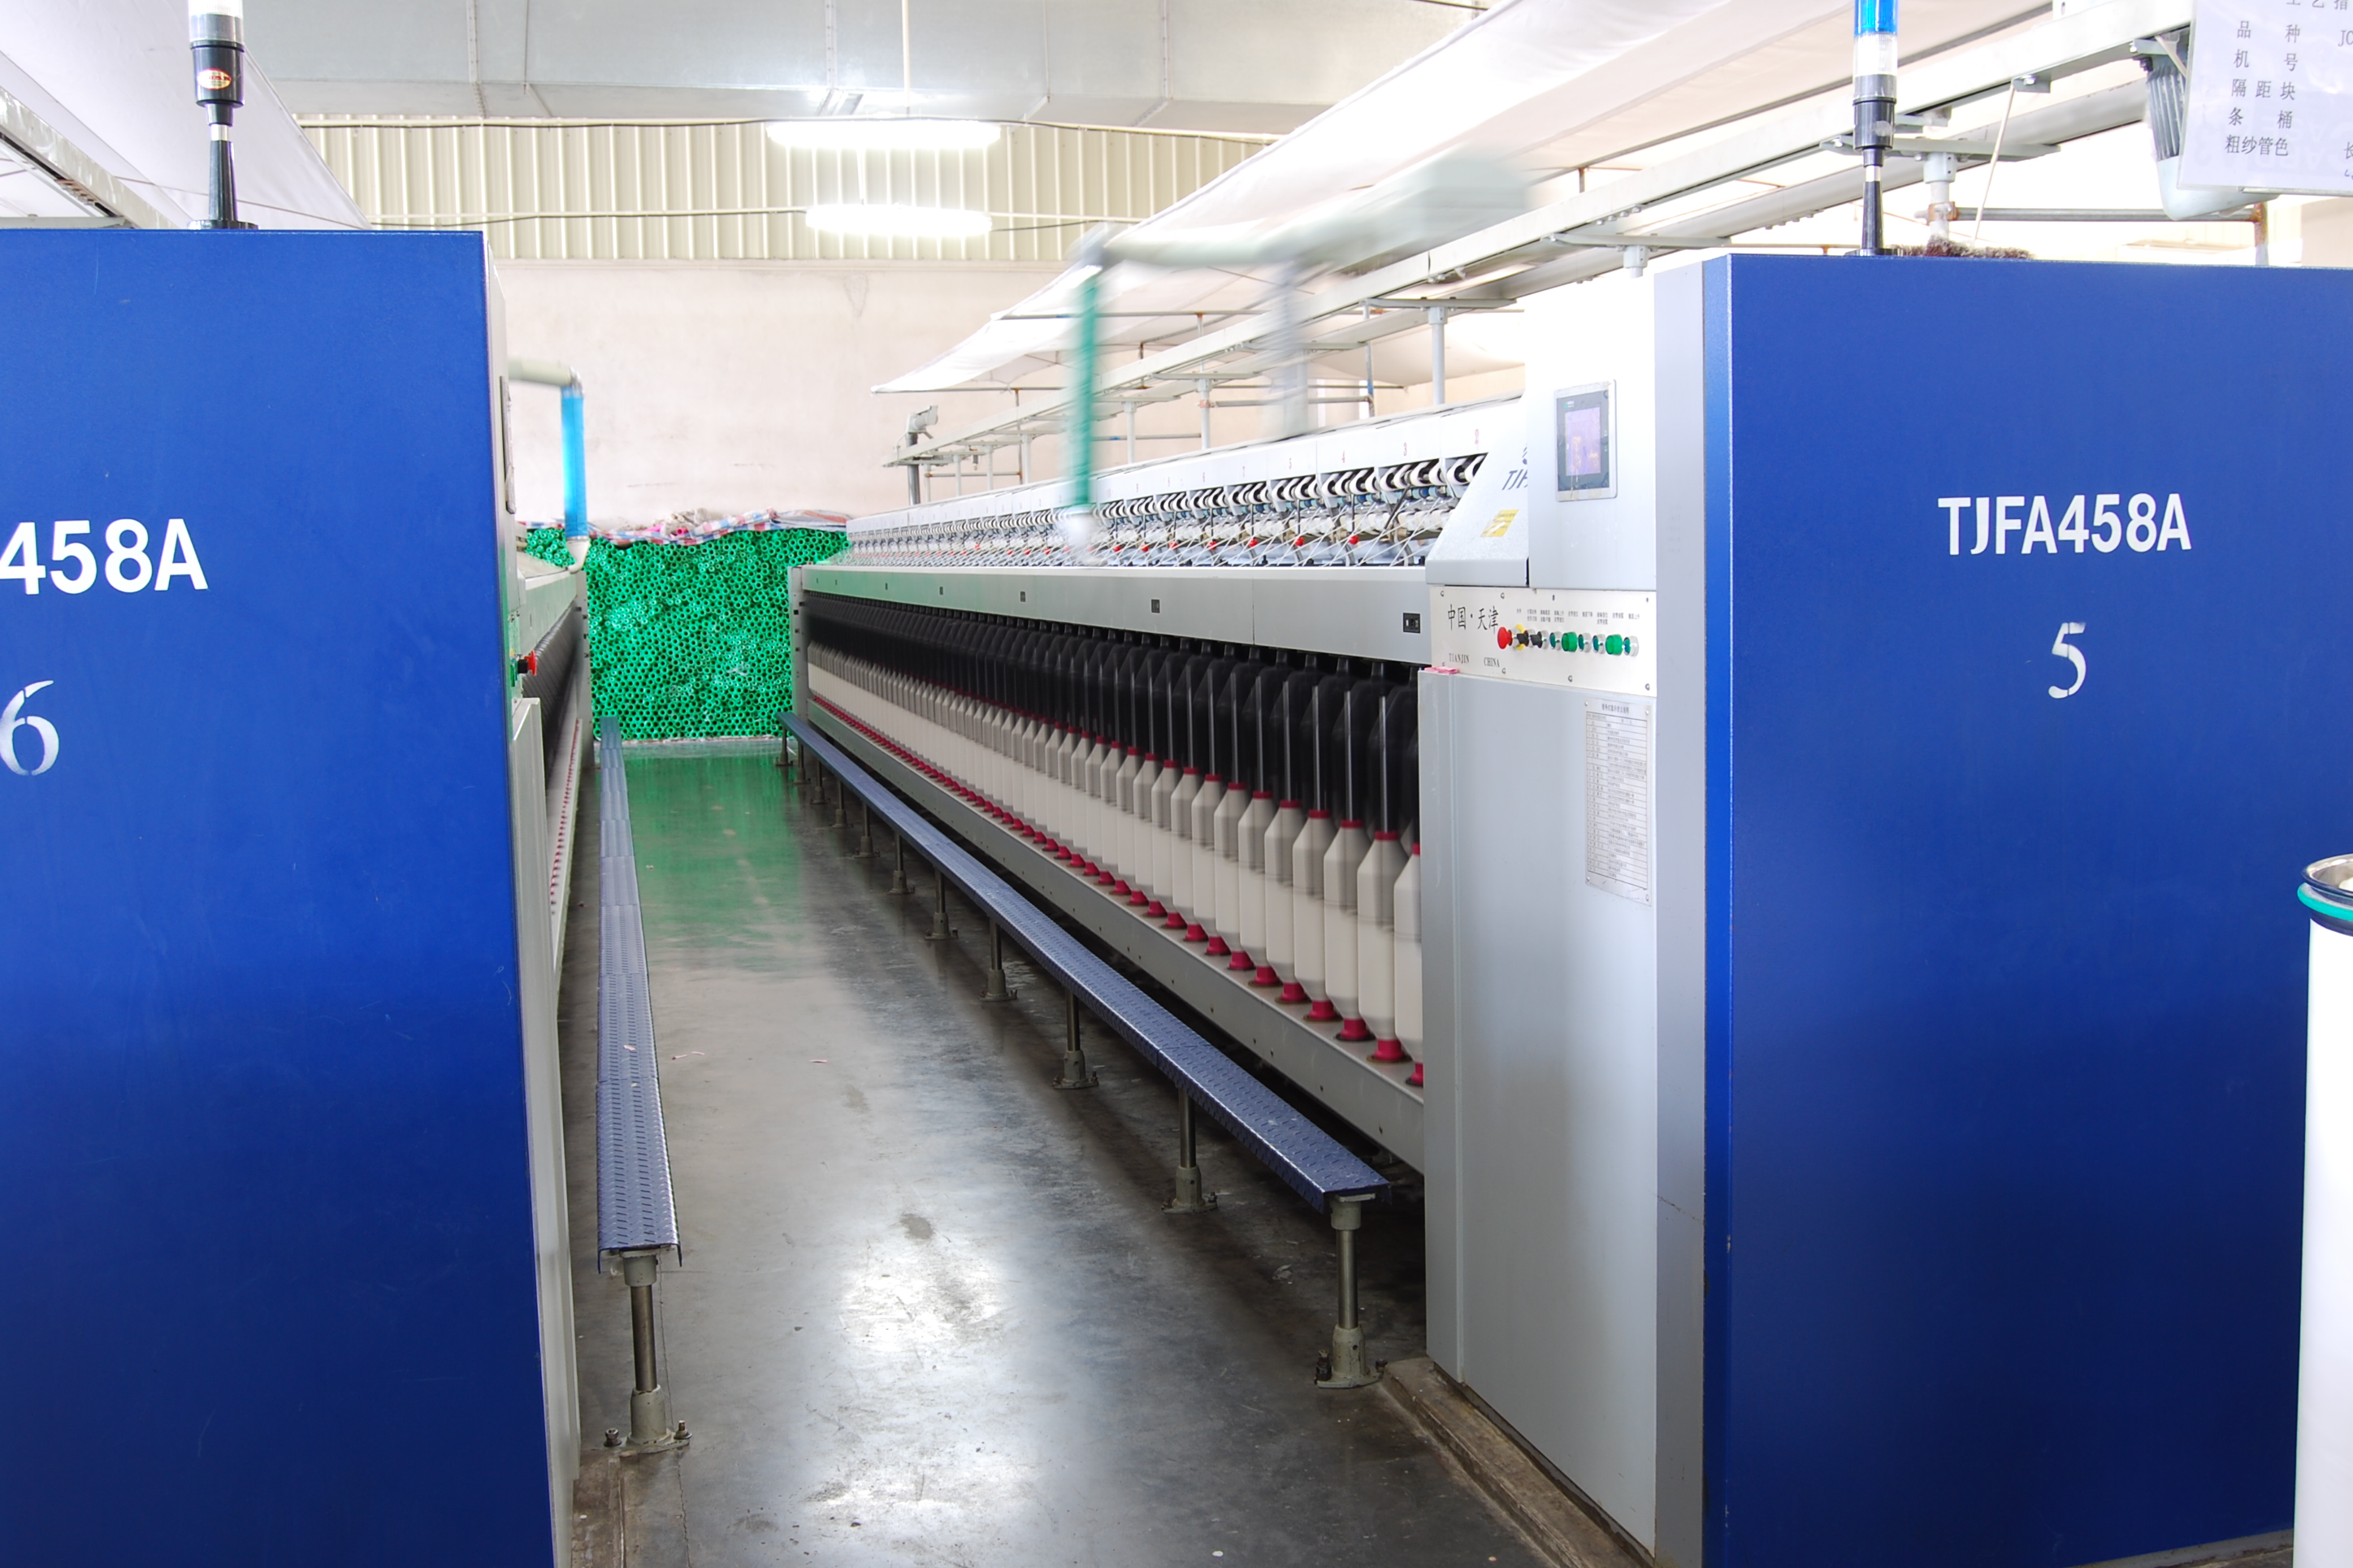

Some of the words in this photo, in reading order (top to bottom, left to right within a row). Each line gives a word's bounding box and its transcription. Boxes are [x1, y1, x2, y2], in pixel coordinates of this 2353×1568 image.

[2230, 78, 2296, 101] 隔距块
[2225, 134, 2290, 158] 粗纱管色
[1474, 428, 1480, 445] 2
[1402, 441, 1408, 457] 3
[1502, 468, 1528, 491] TJF
[1937, 492, 2192, 556] TJFA458A
[0, 518, 209, 595] 458A
[1449, 652, 1470, 665] TIANJIN
[1484, 656, 1500, 668] CHINA
[2048, 622, 2086, 699] 5
[0, 679, 60, 776] 6
